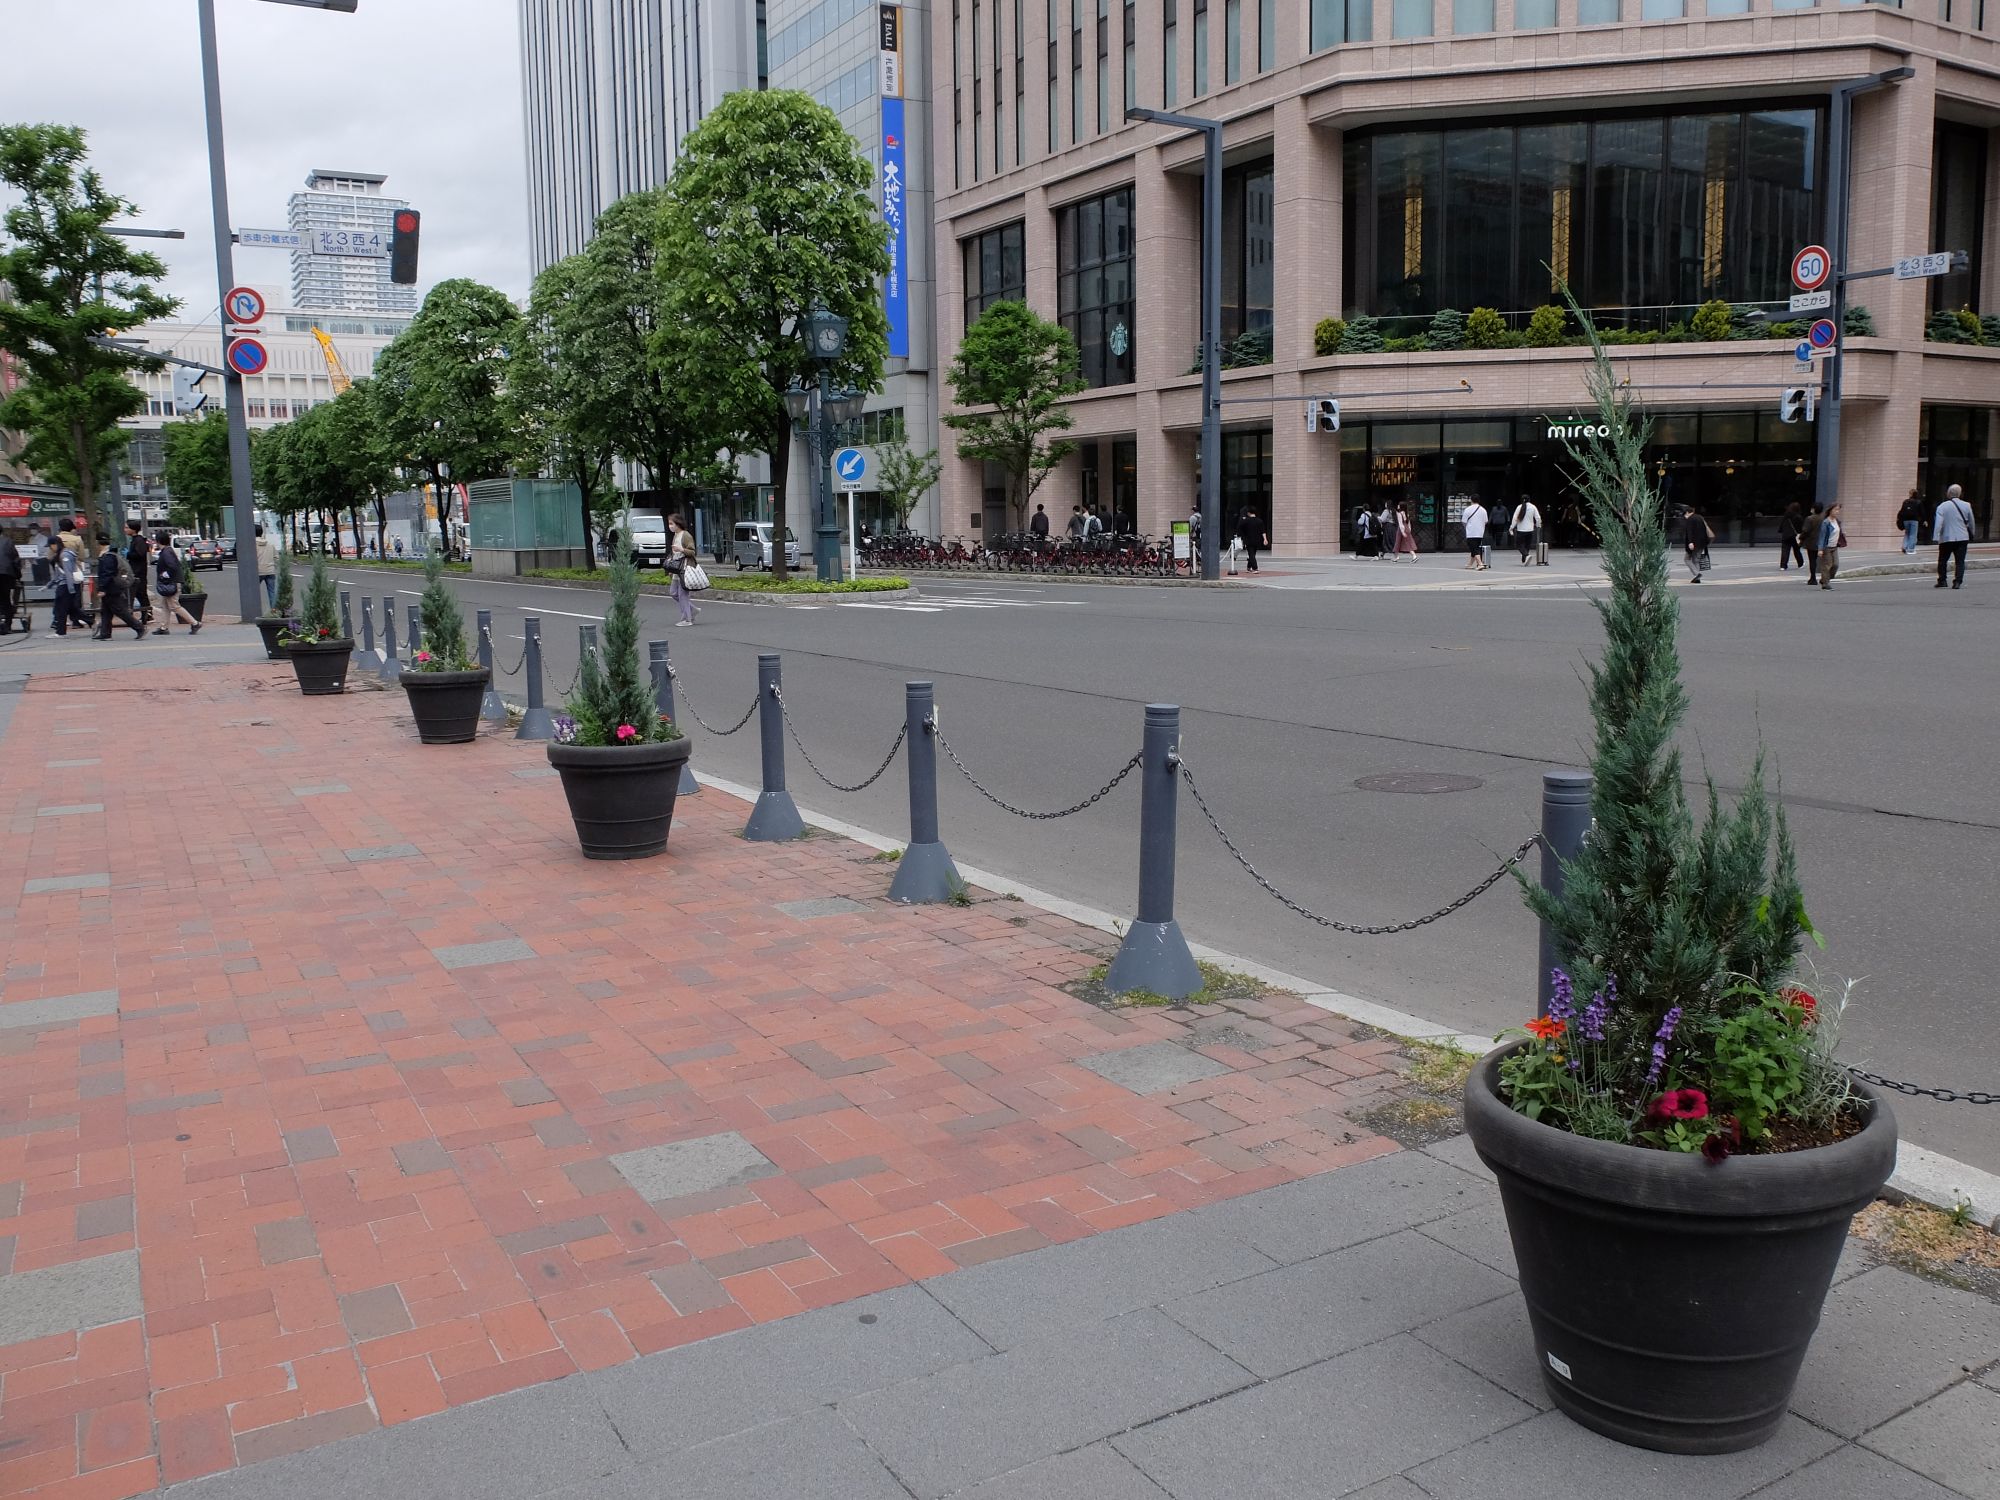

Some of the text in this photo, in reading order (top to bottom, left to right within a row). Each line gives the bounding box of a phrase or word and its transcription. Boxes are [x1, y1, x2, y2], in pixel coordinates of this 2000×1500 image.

[885, 23, 893, 47] BALI
[324, 245, 344, 253] North
[353, 246, 371, 254] West
[1801, 258, 1821, 278] 50
[1899, 254, 1945, 270] 北3西3
[1792, 295, 1827, 308] ここから
